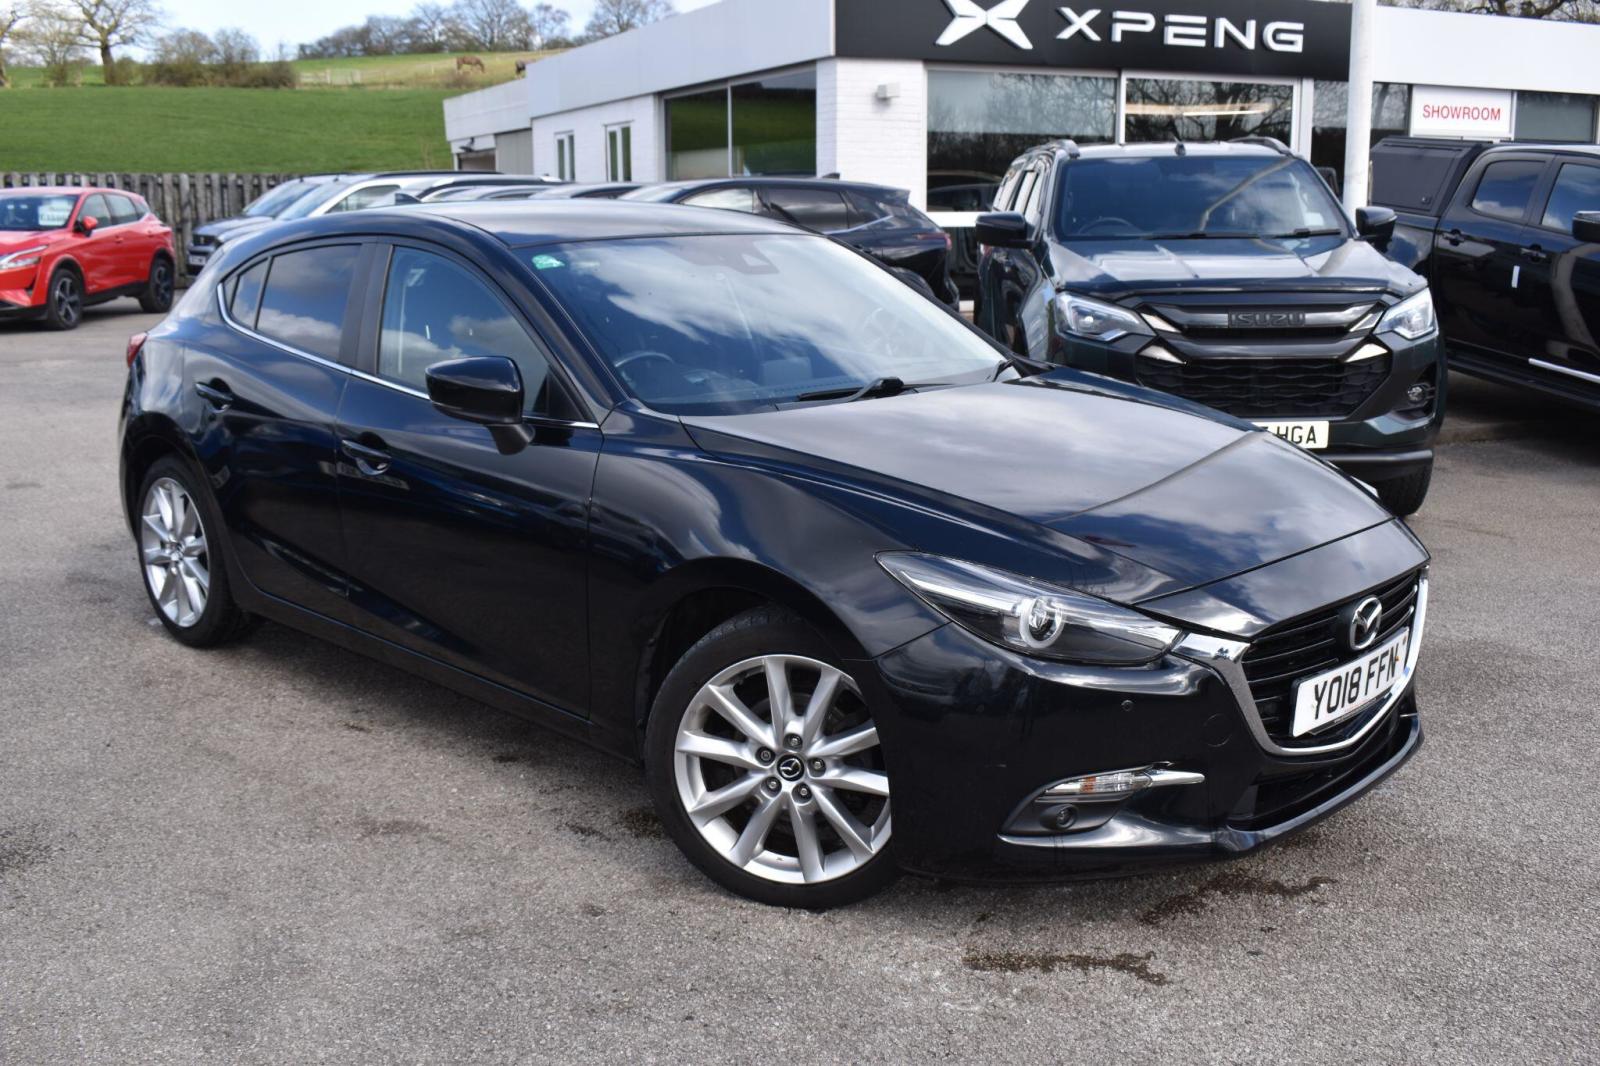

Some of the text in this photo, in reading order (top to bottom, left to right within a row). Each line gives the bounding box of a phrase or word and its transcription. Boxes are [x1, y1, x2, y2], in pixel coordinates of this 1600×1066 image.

[1056, 7, 1304, 53] XPENG
[1423, 104, 1501, 121] SHOWROOM
[1231, 313, 1304, 326] ISUZU
[1365, 643, 1399, 696] FFN
